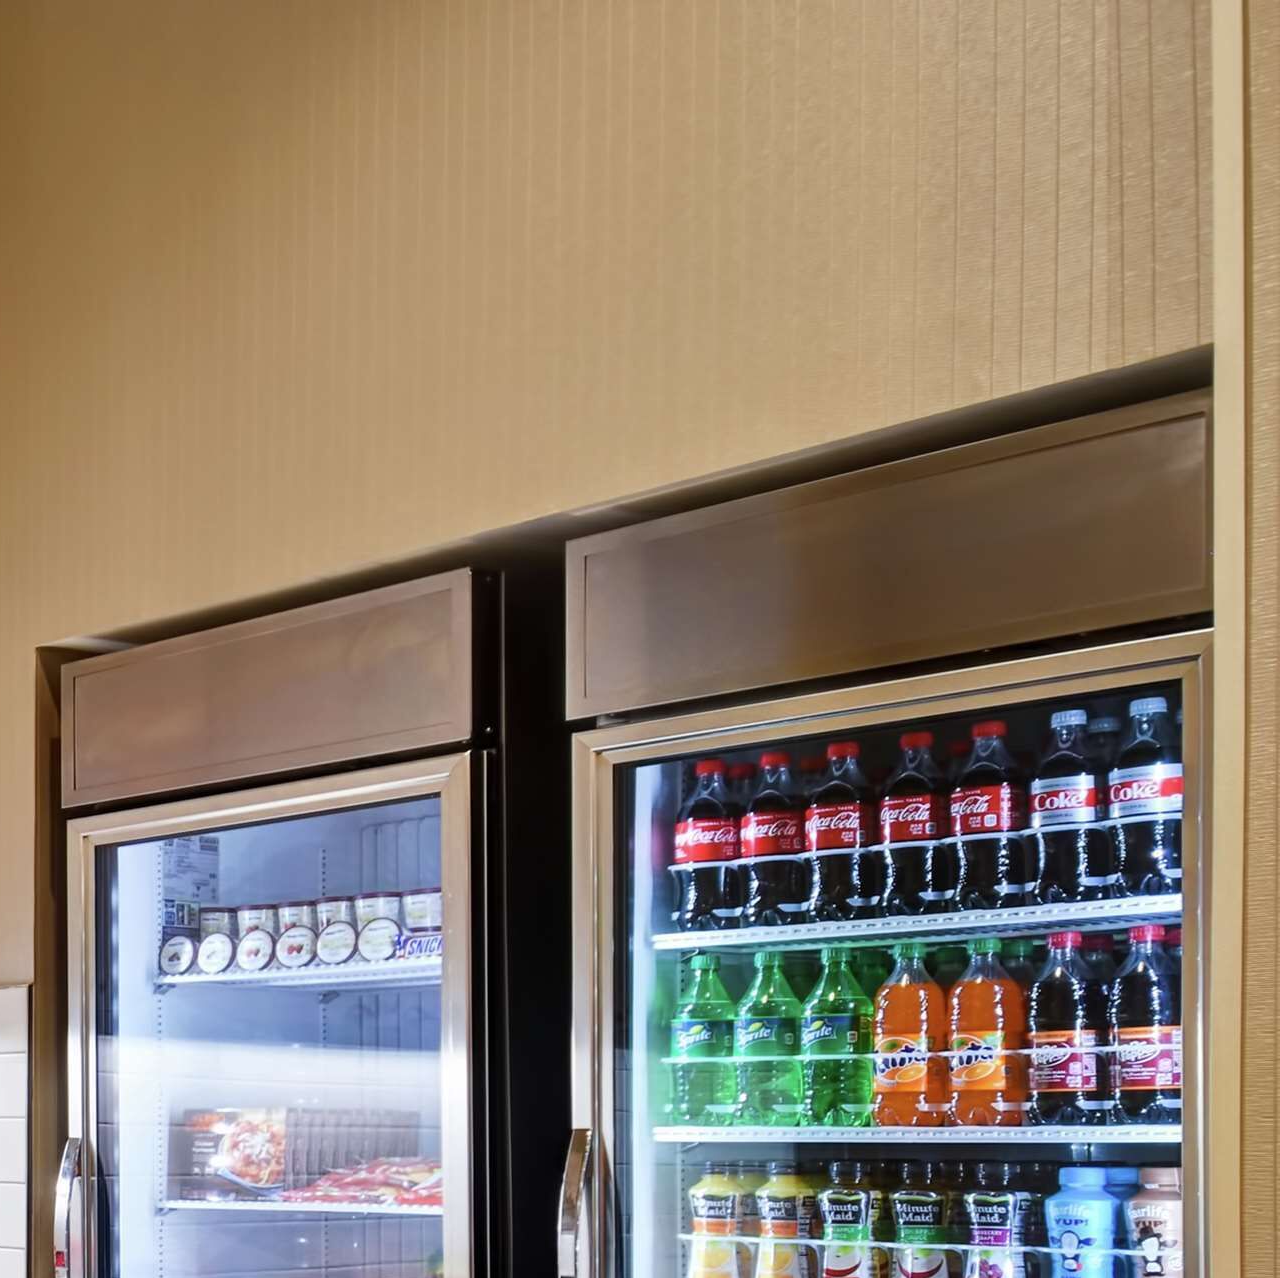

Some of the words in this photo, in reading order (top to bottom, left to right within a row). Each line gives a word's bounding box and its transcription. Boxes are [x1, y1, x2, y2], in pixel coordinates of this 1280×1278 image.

[1034, 790, 1086, 811] Coke
[1110, 780, 1160, 802] Coke
[407, 937, 442, 956] SNIC
